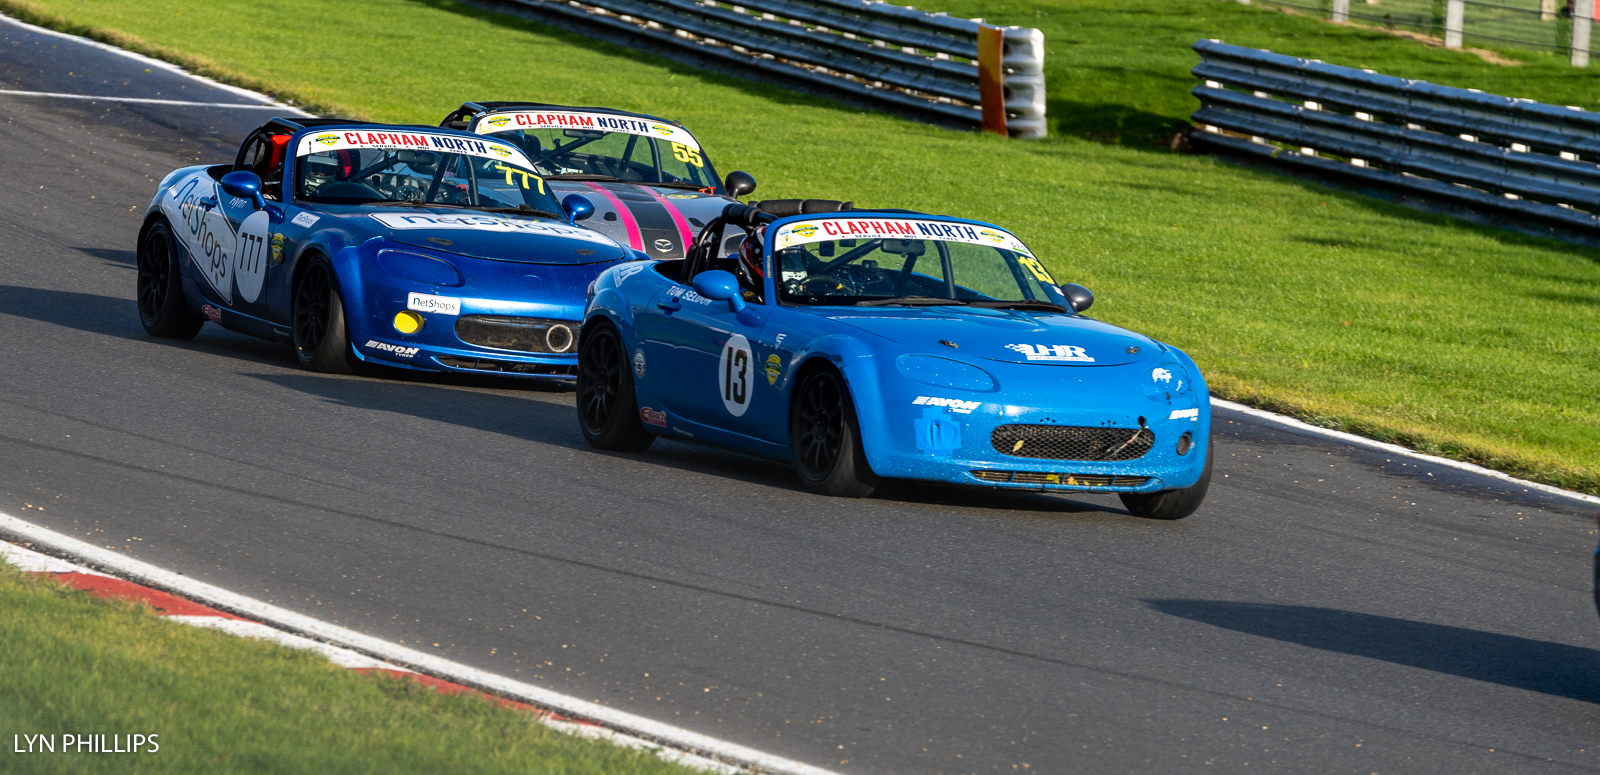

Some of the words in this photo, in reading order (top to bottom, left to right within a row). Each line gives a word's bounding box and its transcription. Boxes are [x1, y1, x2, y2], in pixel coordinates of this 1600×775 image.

[515, 114, 594, 127] CLAPHAM
[597, 117, 649, 133] NORTH
[344, 132, 430, 146] CLAPHAM
[431, 136, 487, 154] NORTH
[671, 141, 704, 168] 55
[495, 164, 546, 196] 777
[822, 221, 916, 235] CLAPHAM
[916, 222, 980, 240] NORTH
[239, 232, 263, 274] 777
[1018, 256, 1055, 285] 13
[665, 285, 686, 298] TOM
[376, 342, 421, 355] AVON
[725, 346, 749, 405] 13
[926, 397, 982, 411] AVON
